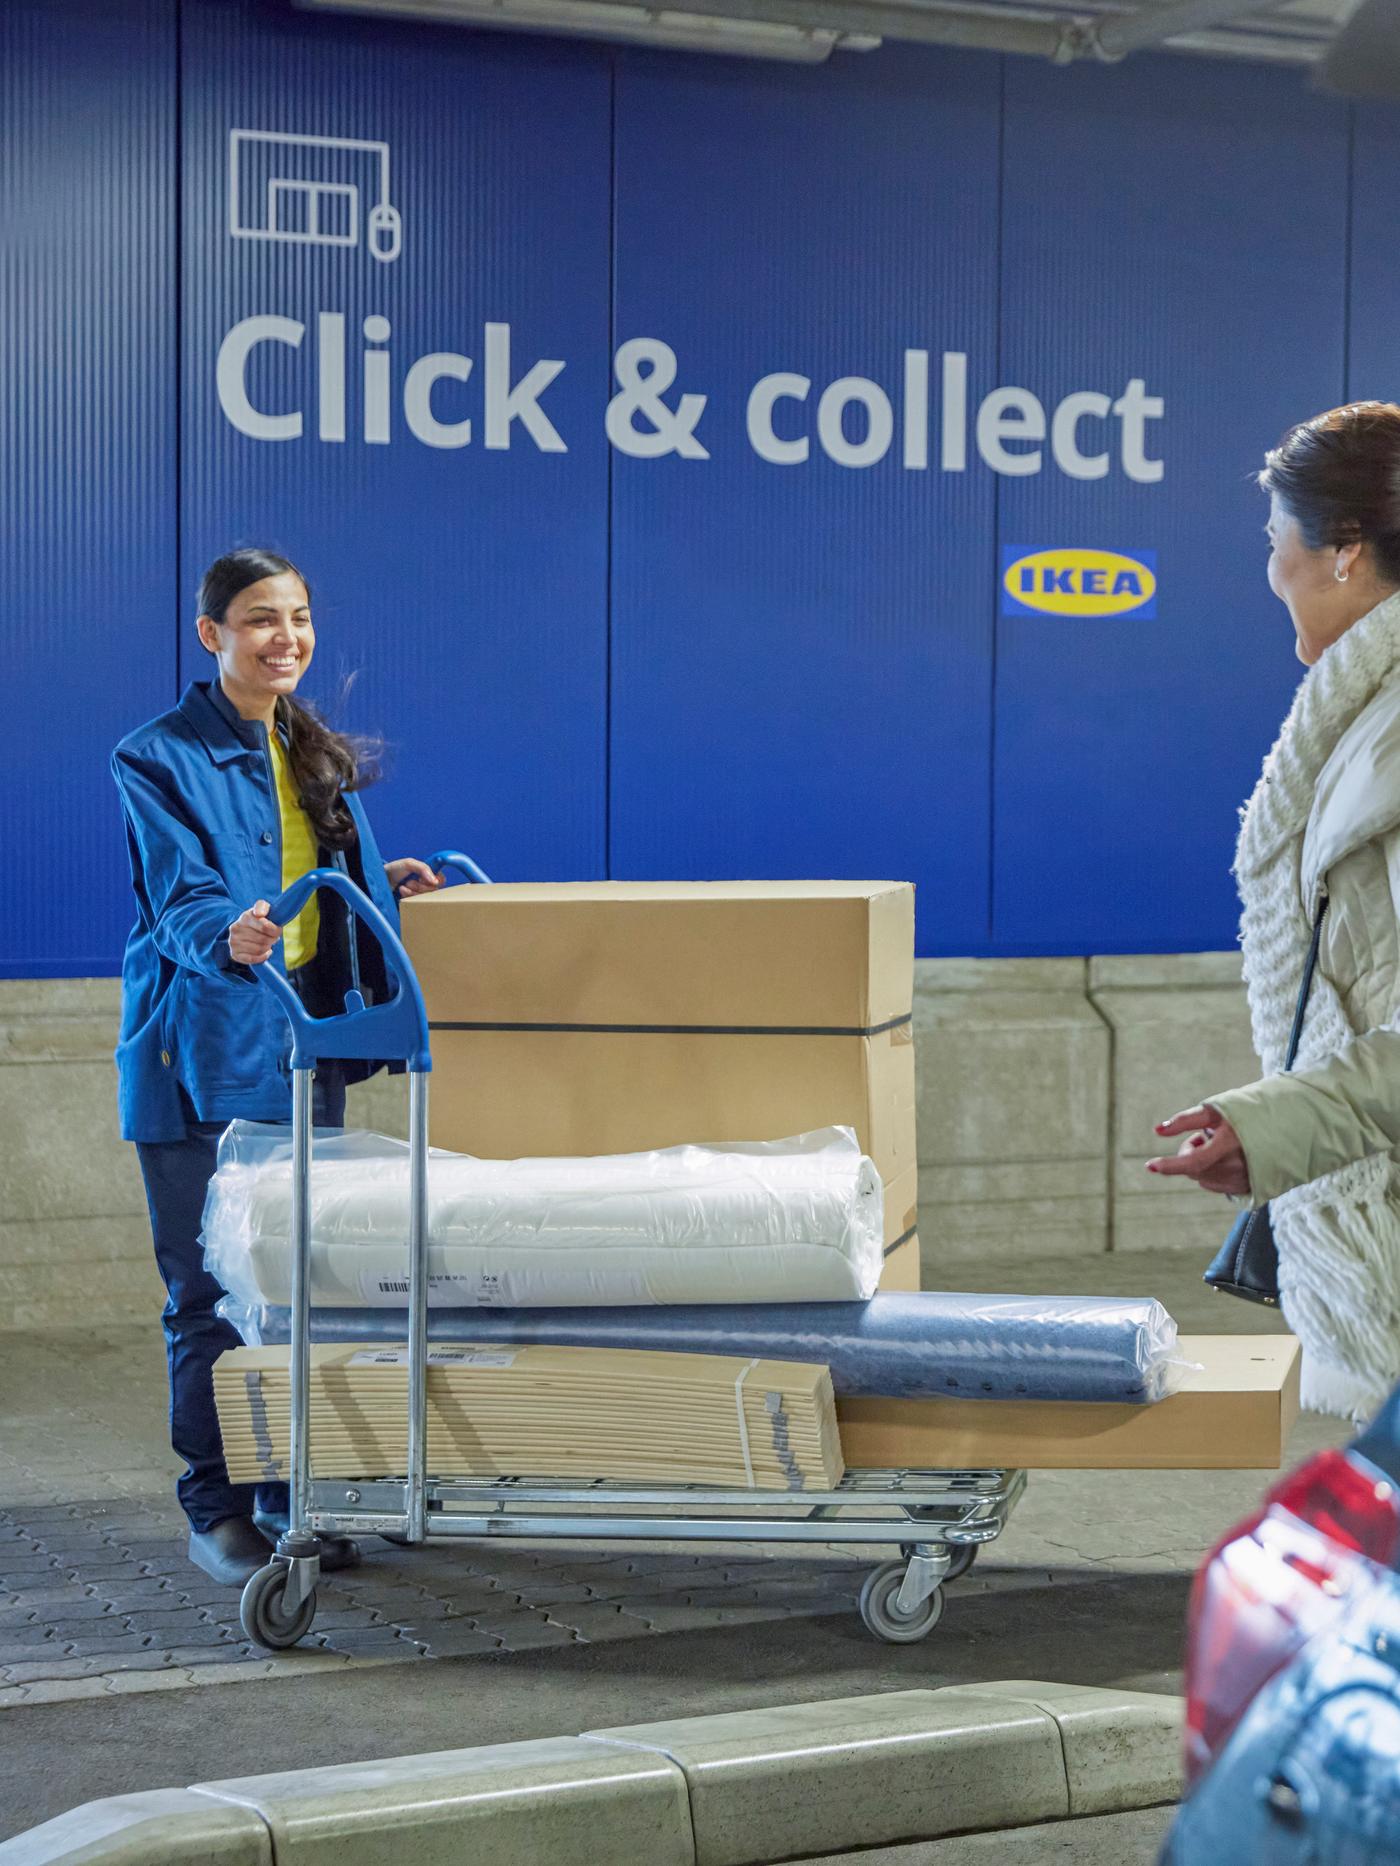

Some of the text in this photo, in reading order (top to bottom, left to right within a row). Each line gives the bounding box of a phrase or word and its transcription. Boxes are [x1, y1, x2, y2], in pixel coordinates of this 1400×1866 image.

[216, 311, 1164, 483] Click & collect
[1020, 567, 1144, 596] IKEA
